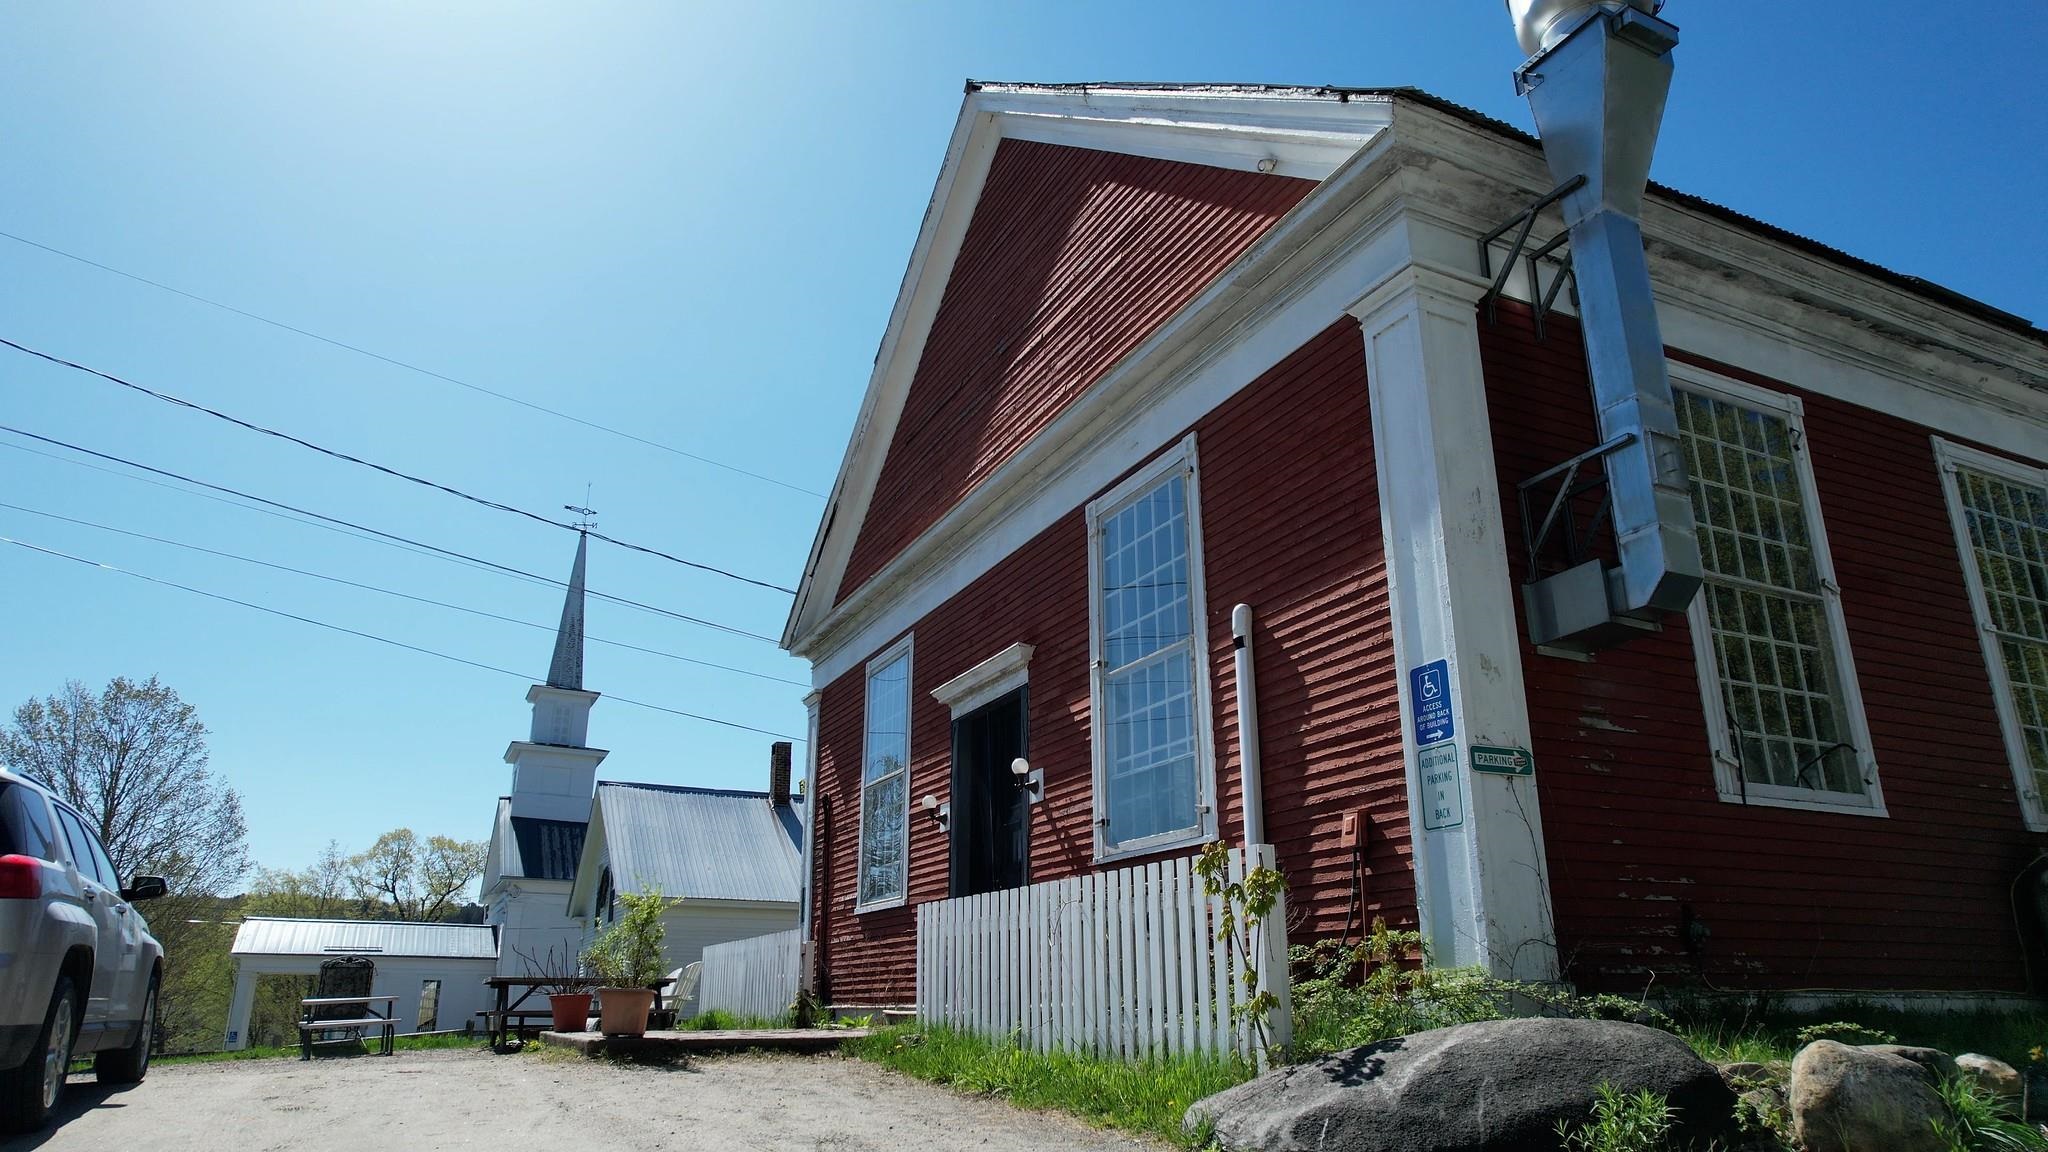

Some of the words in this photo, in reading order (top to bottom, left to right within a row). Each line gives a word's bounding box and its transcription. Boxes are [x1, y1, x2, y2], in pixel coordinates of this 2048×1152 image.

[1423, 700, 1442, 713] ACCESS
[1417, 712, 1436, 723] AROUND
[1436, 708, 1449, 718] BACK
[1419, 723, 1426, 731] OF
[1426, 717, 1449, 729] BUILDING
[1421, 752, 1455, 769] ADDITIONAL
[1477, 753, 1513, 766] PARKING
[1426, 770, 1453, 785] PARKING
[1437, 790, 1445, 801] IN
[1435, 807, 1451, 820] BACK
